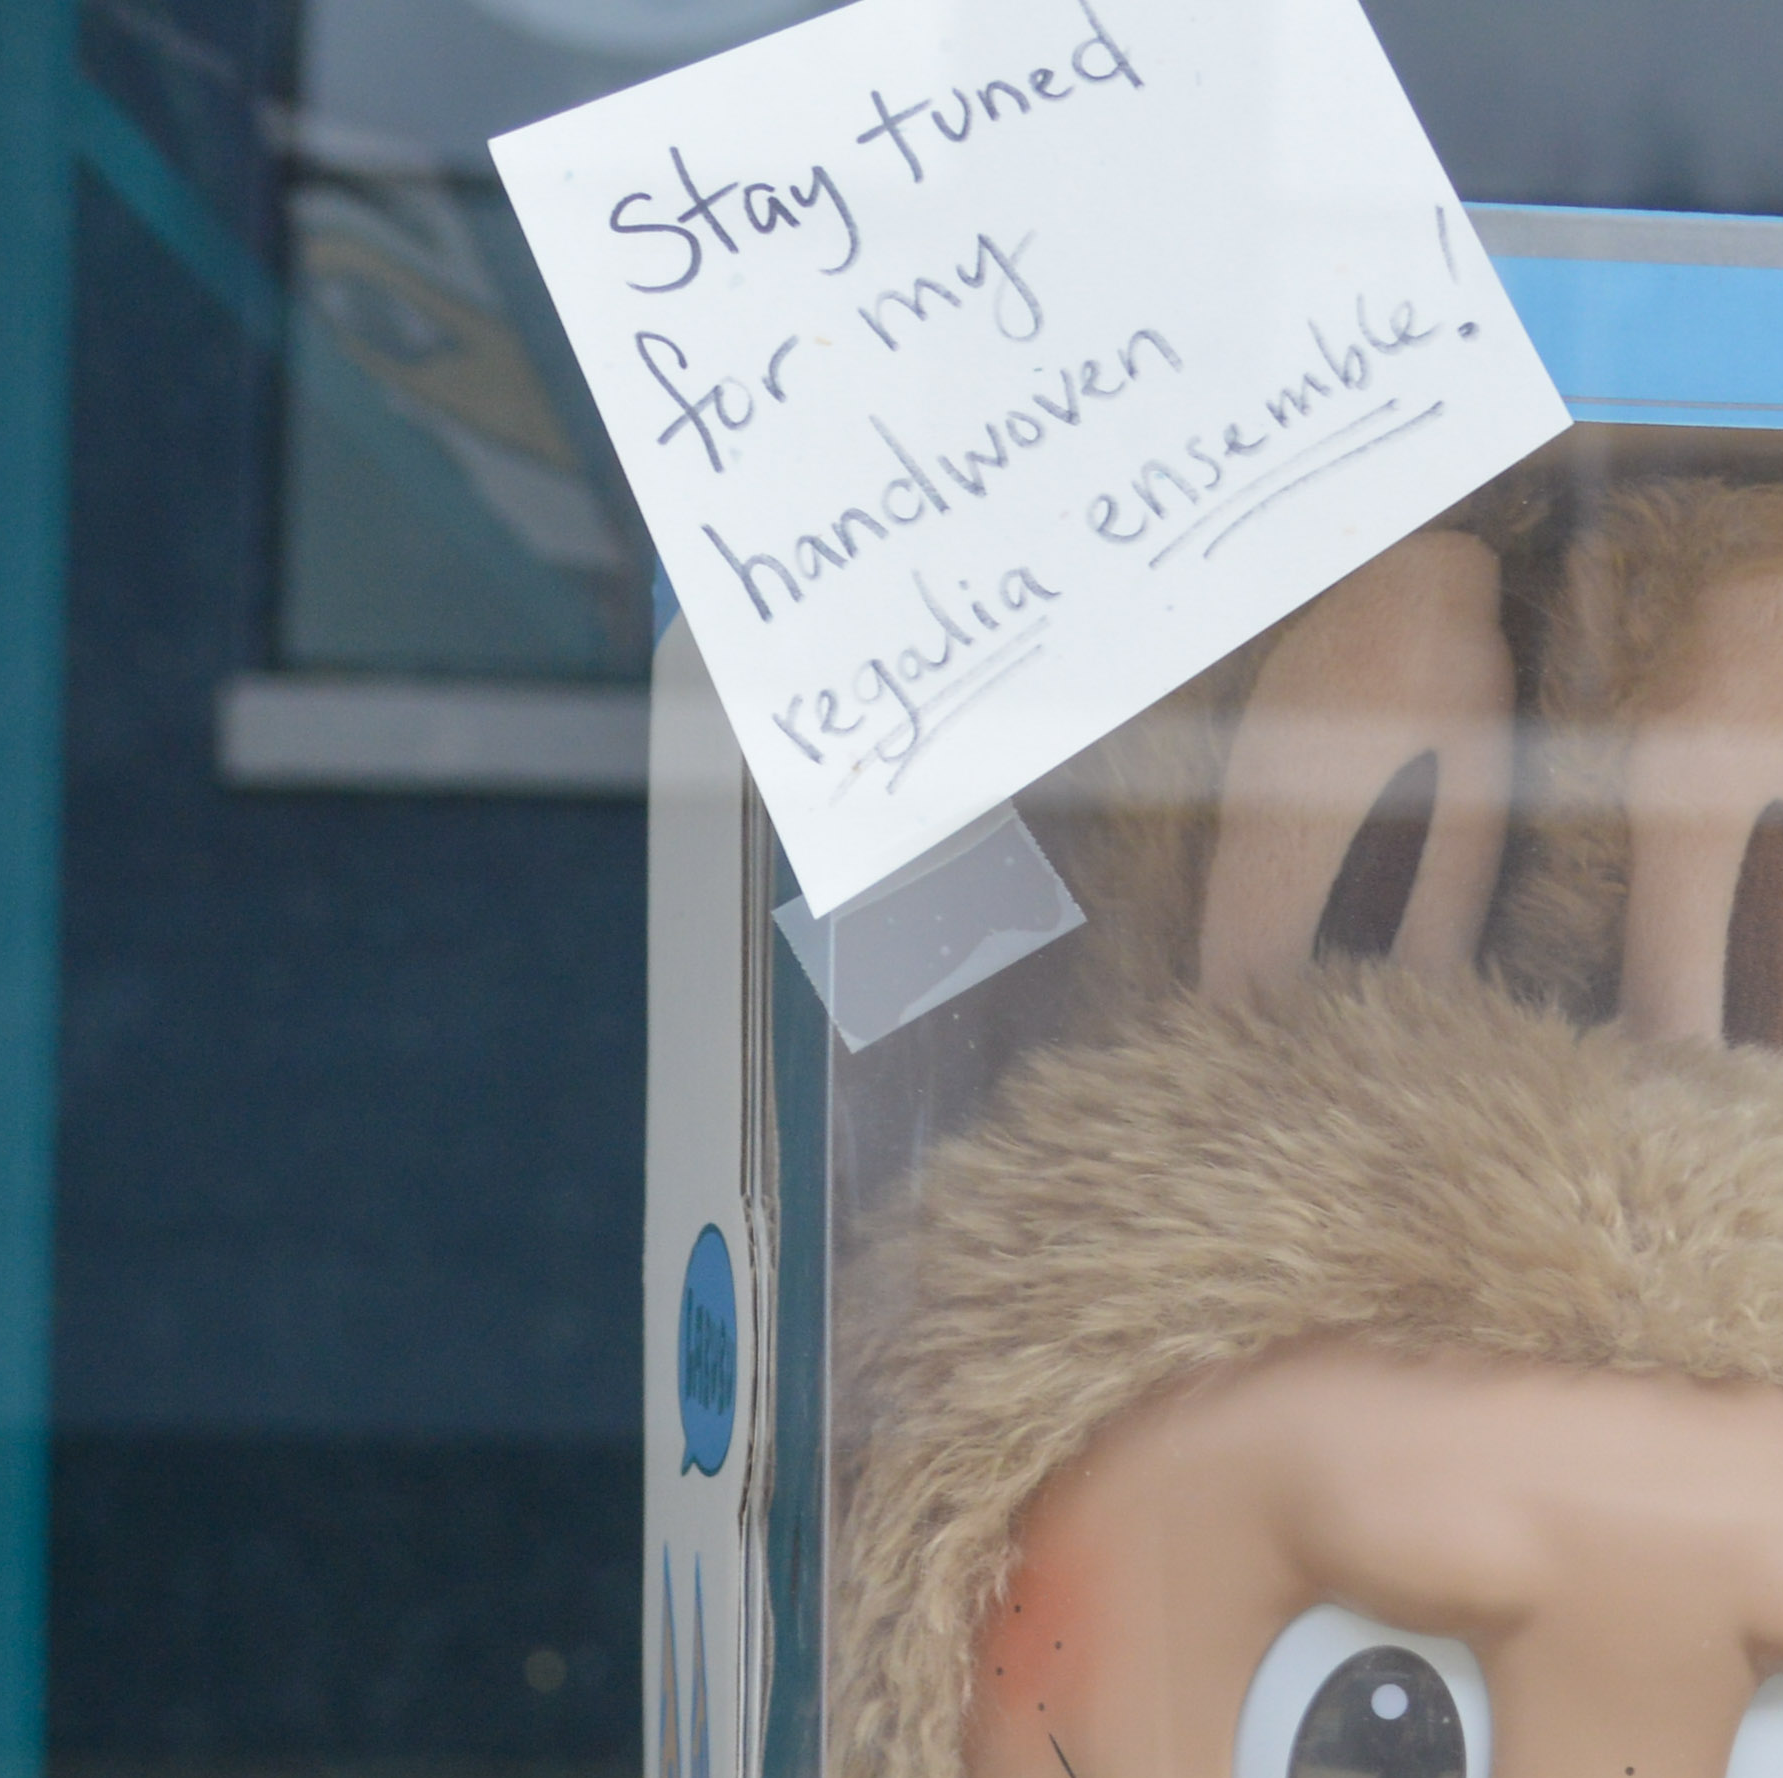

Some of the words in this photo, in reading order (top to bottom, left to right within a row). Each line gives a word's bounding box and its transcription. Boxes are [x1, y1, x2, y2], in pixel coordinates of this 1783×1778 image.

[609, 147, 861, 294] Stay
[857, 0, 1144, 184] tuned
[634, 331, 801, 473] for
[859, 229, 1041, 352] my
[701, 321, 1184, 623] handwoven
[771, 562, 1062, 765] regalia
[1087, 206, 1481, 545] ensemble!
